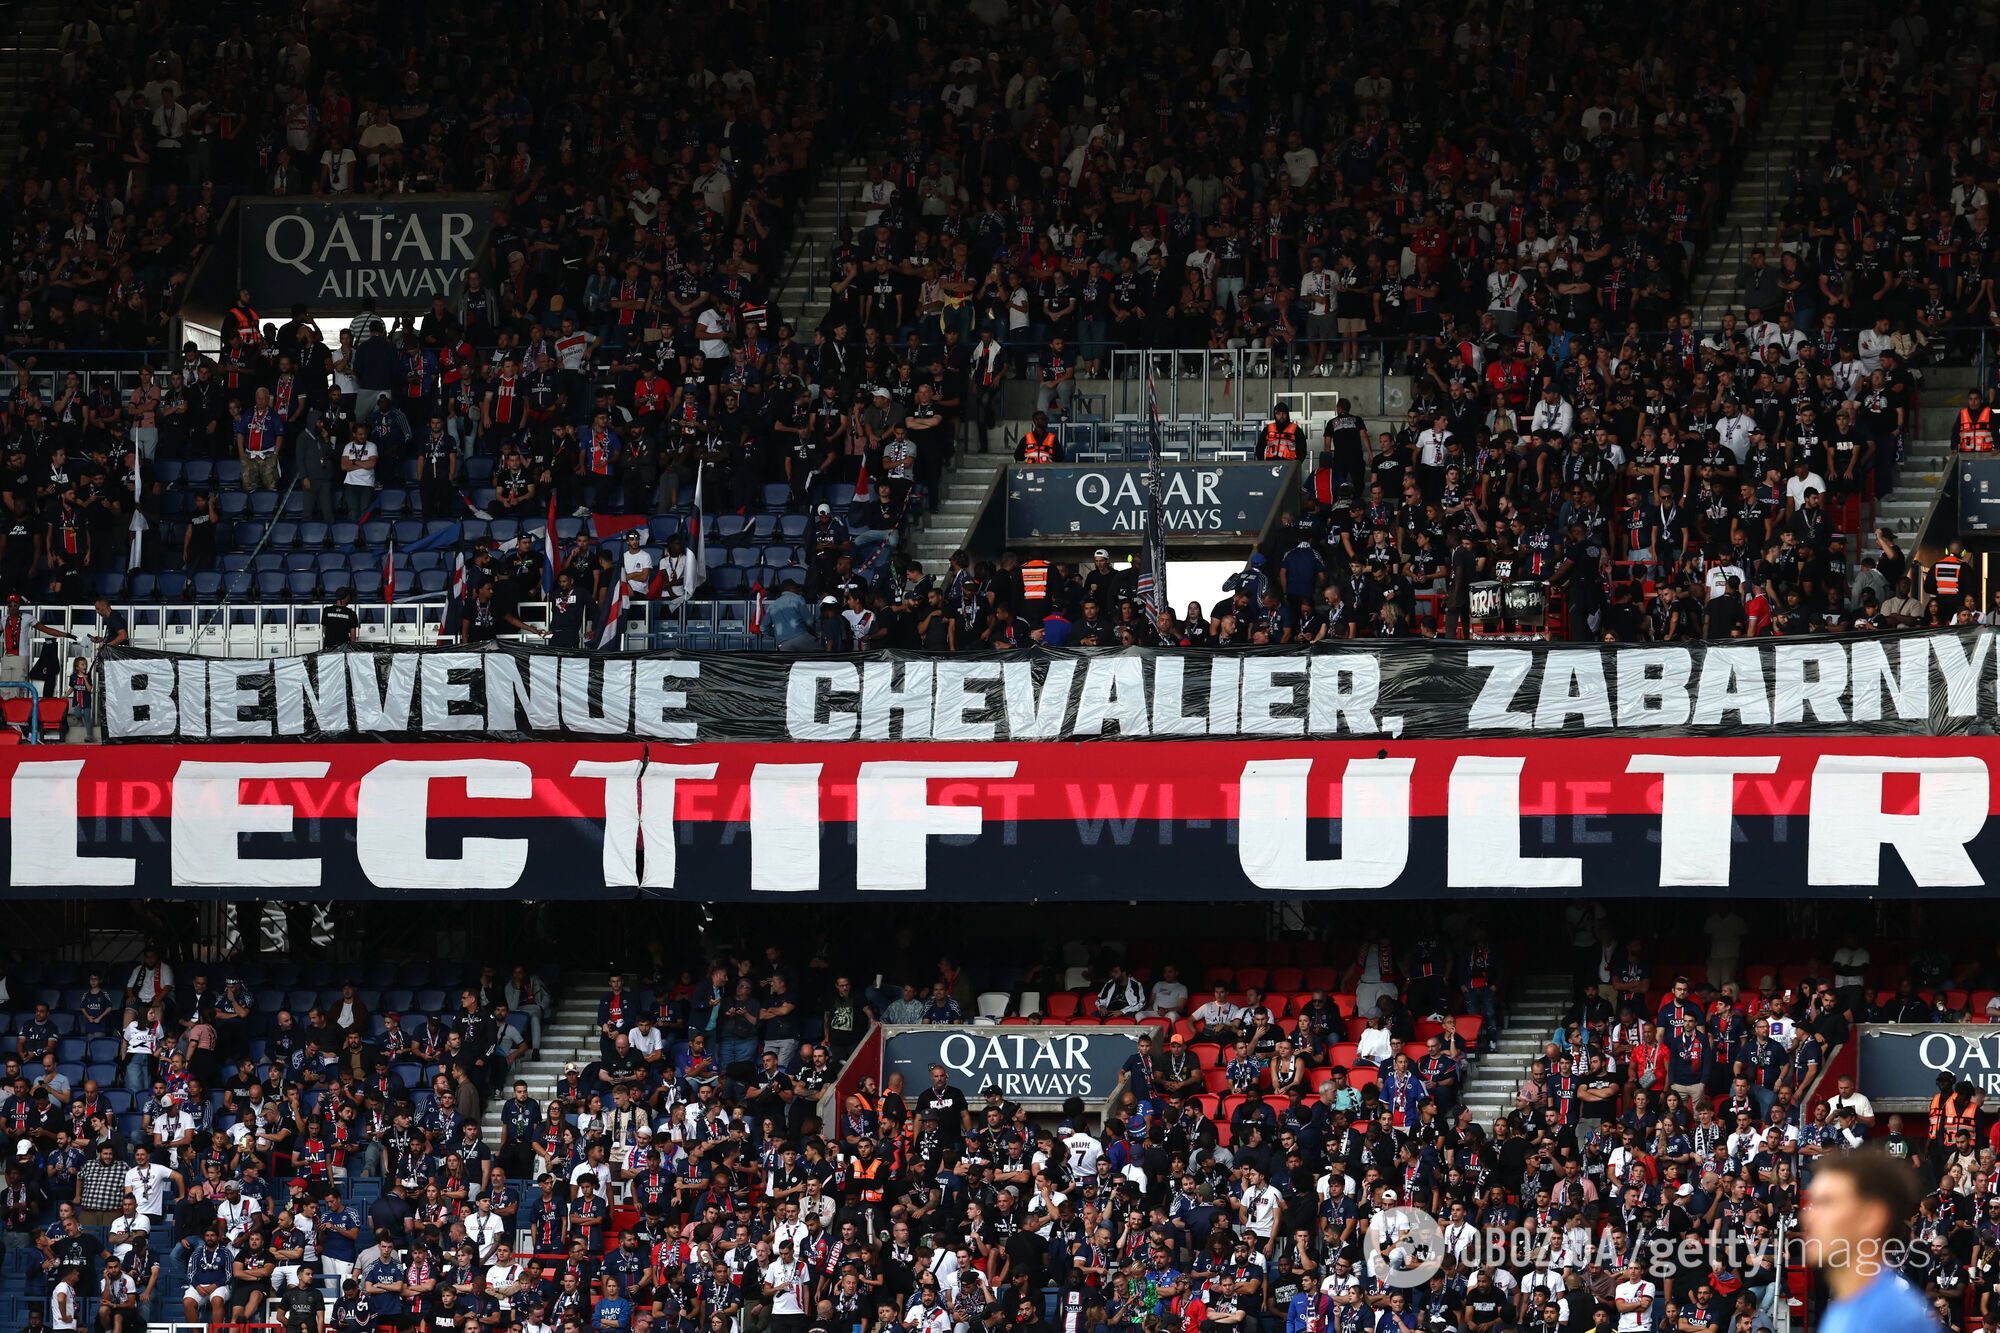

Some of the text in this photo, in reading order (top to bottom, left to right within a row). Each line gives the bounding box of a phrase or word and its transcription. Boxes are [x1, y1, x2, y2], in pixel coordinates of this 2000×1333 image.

[265, 213, 475, 275] QATAR
[498, 386, 516, 397] RTL
[1627, 521, 1643, 529] QATAR
[1529, 540, 1547, 548] QATAR
[105, 633, 2000, 740] BIENVENUE CHEVALIER, ZABARNY
[10, 754, 1990, 891] LECTIF ULTR
[940, 1034, 1091, 1077] QATAR
[978, 1073, 1091, 1095] AIRWAYS
[1888, 1142, 1902, 1154] 30
[1076, 1150, 1086, 1167] 7
[1688, 1317, 1707, 1325] QATAR
